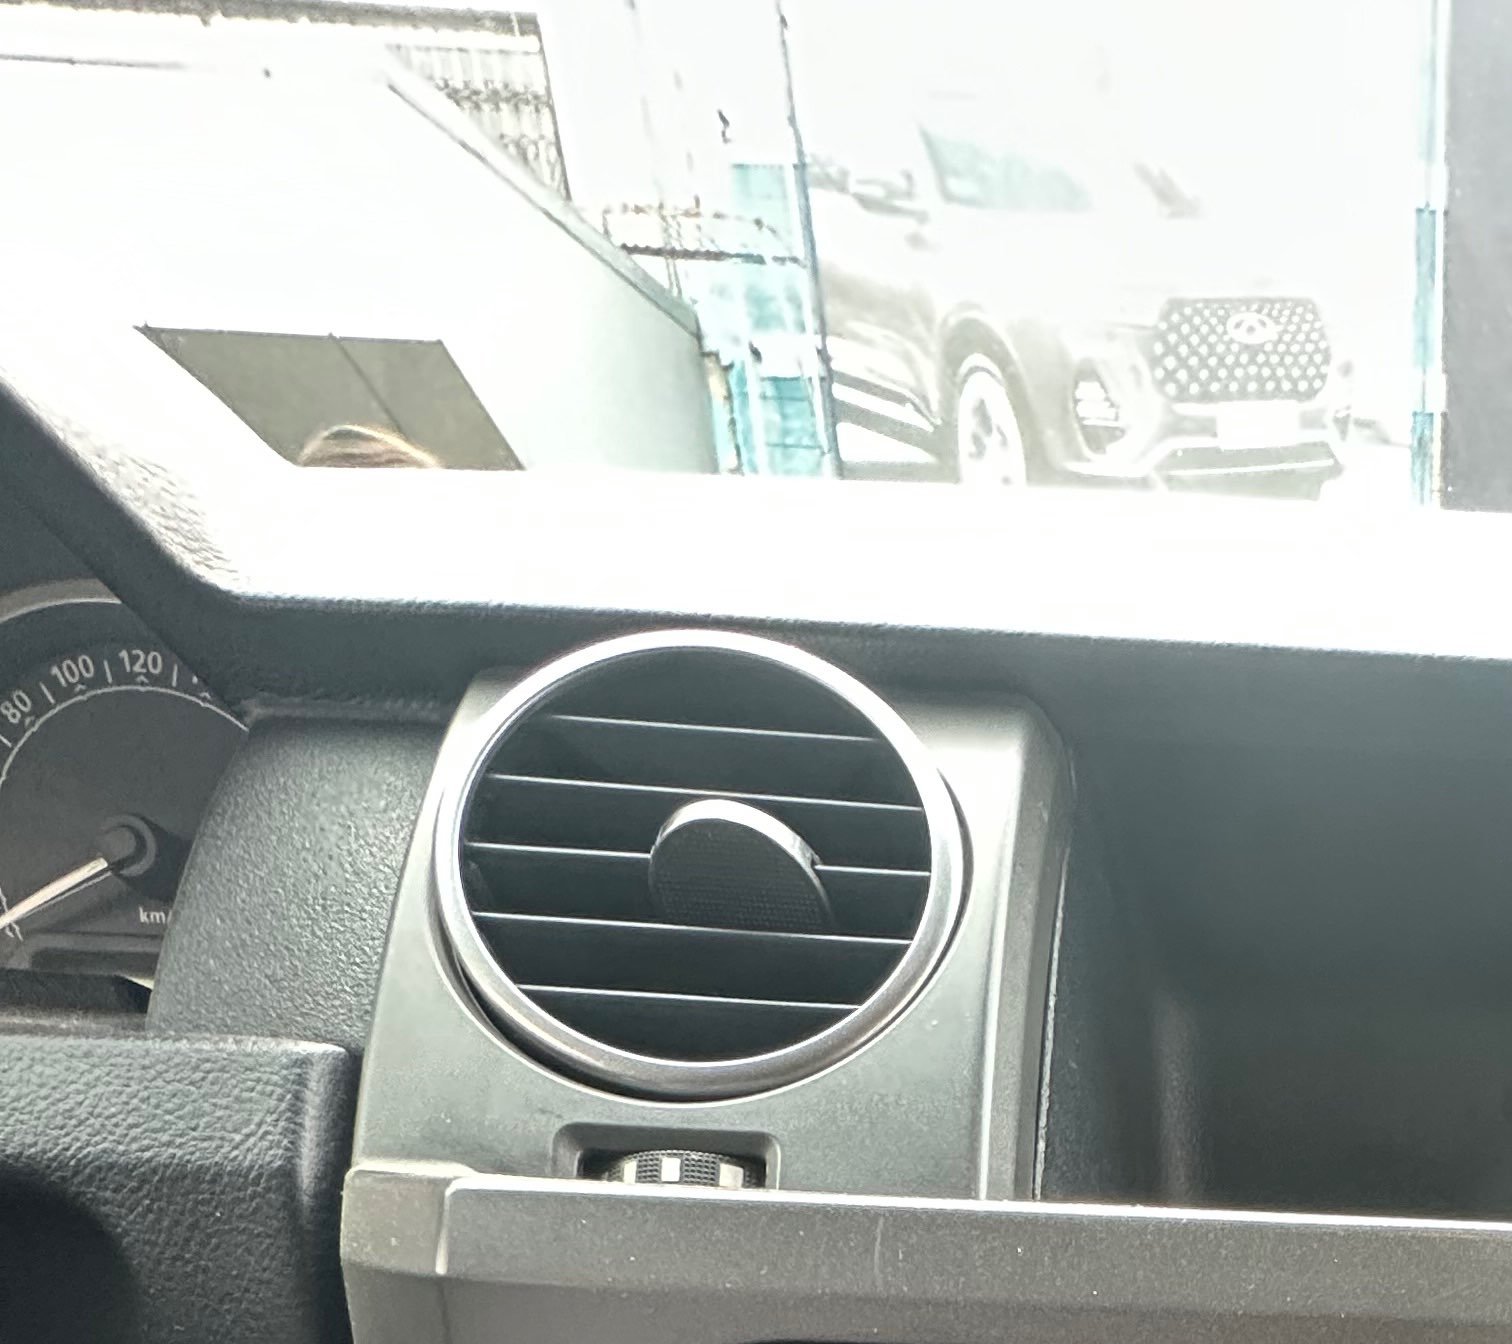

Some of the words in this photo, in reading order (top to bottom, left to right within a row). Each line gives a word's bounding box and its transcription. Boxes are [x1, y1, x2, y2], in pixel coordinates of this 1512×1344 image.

[50, 655, 95, 687] 100
[118, 649, 163, 674] 120
[0, 690, 31, 723] 80
